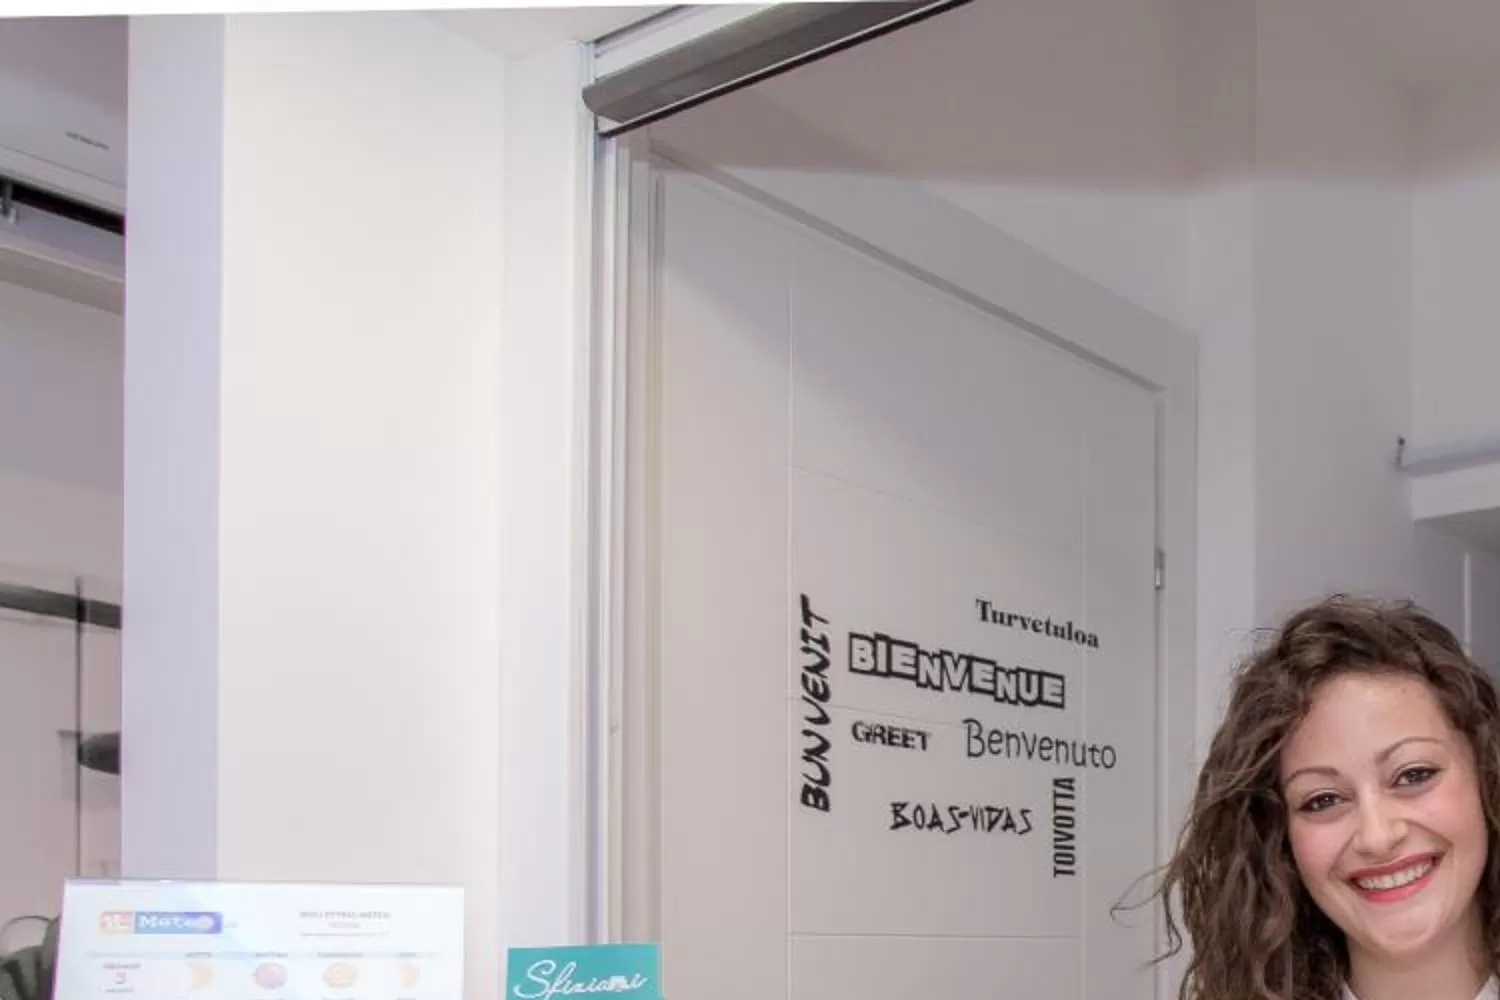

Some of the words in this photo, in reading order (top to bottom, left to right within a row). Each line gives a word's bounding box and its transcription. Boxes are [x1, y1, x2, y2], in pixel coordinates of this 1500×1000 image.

[975, 598, 1099, 648] Turvetuloa
[848, 631, 1066, 709] BIENVENUE
[851, 720, 932, 751] GREET
[962, 717, 1117, 769] Benvenuto
[889, 801, 1033, 836] BOAS-VIDAS
